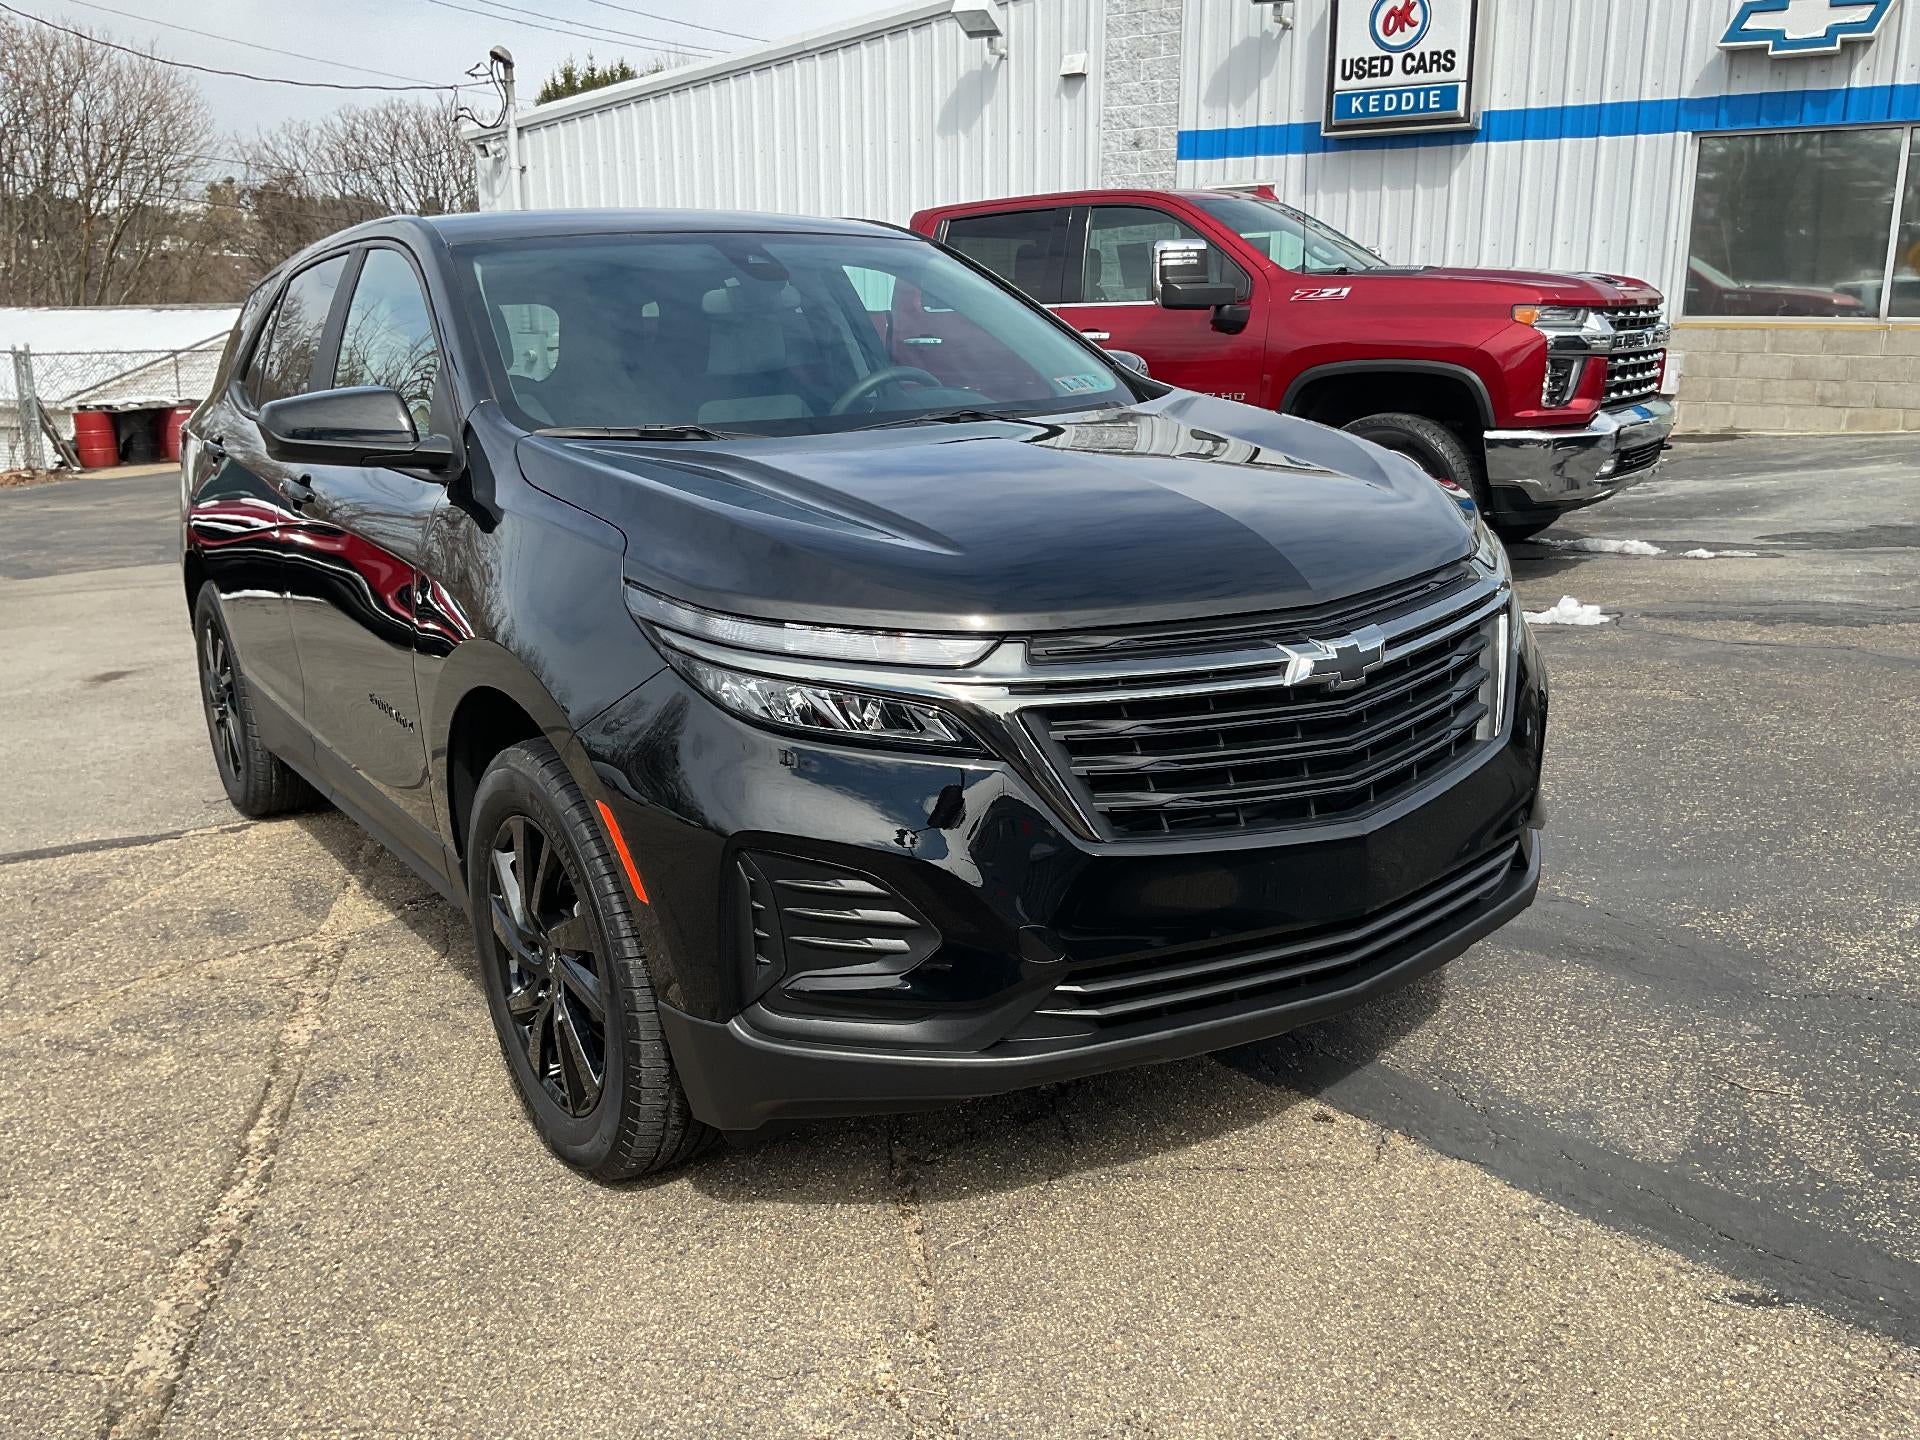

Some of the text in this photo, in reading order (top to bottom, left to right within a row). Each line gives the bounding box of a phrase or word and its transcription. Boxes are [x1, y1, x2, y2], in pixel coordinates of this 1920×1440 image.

[1382, 0, 1419, 37] OK
[1341, 49, 1457, 81] USED CARS
[1351, 90, 1441, 114] KEDDIE
[1290, 287, 1352, 301] Z71
